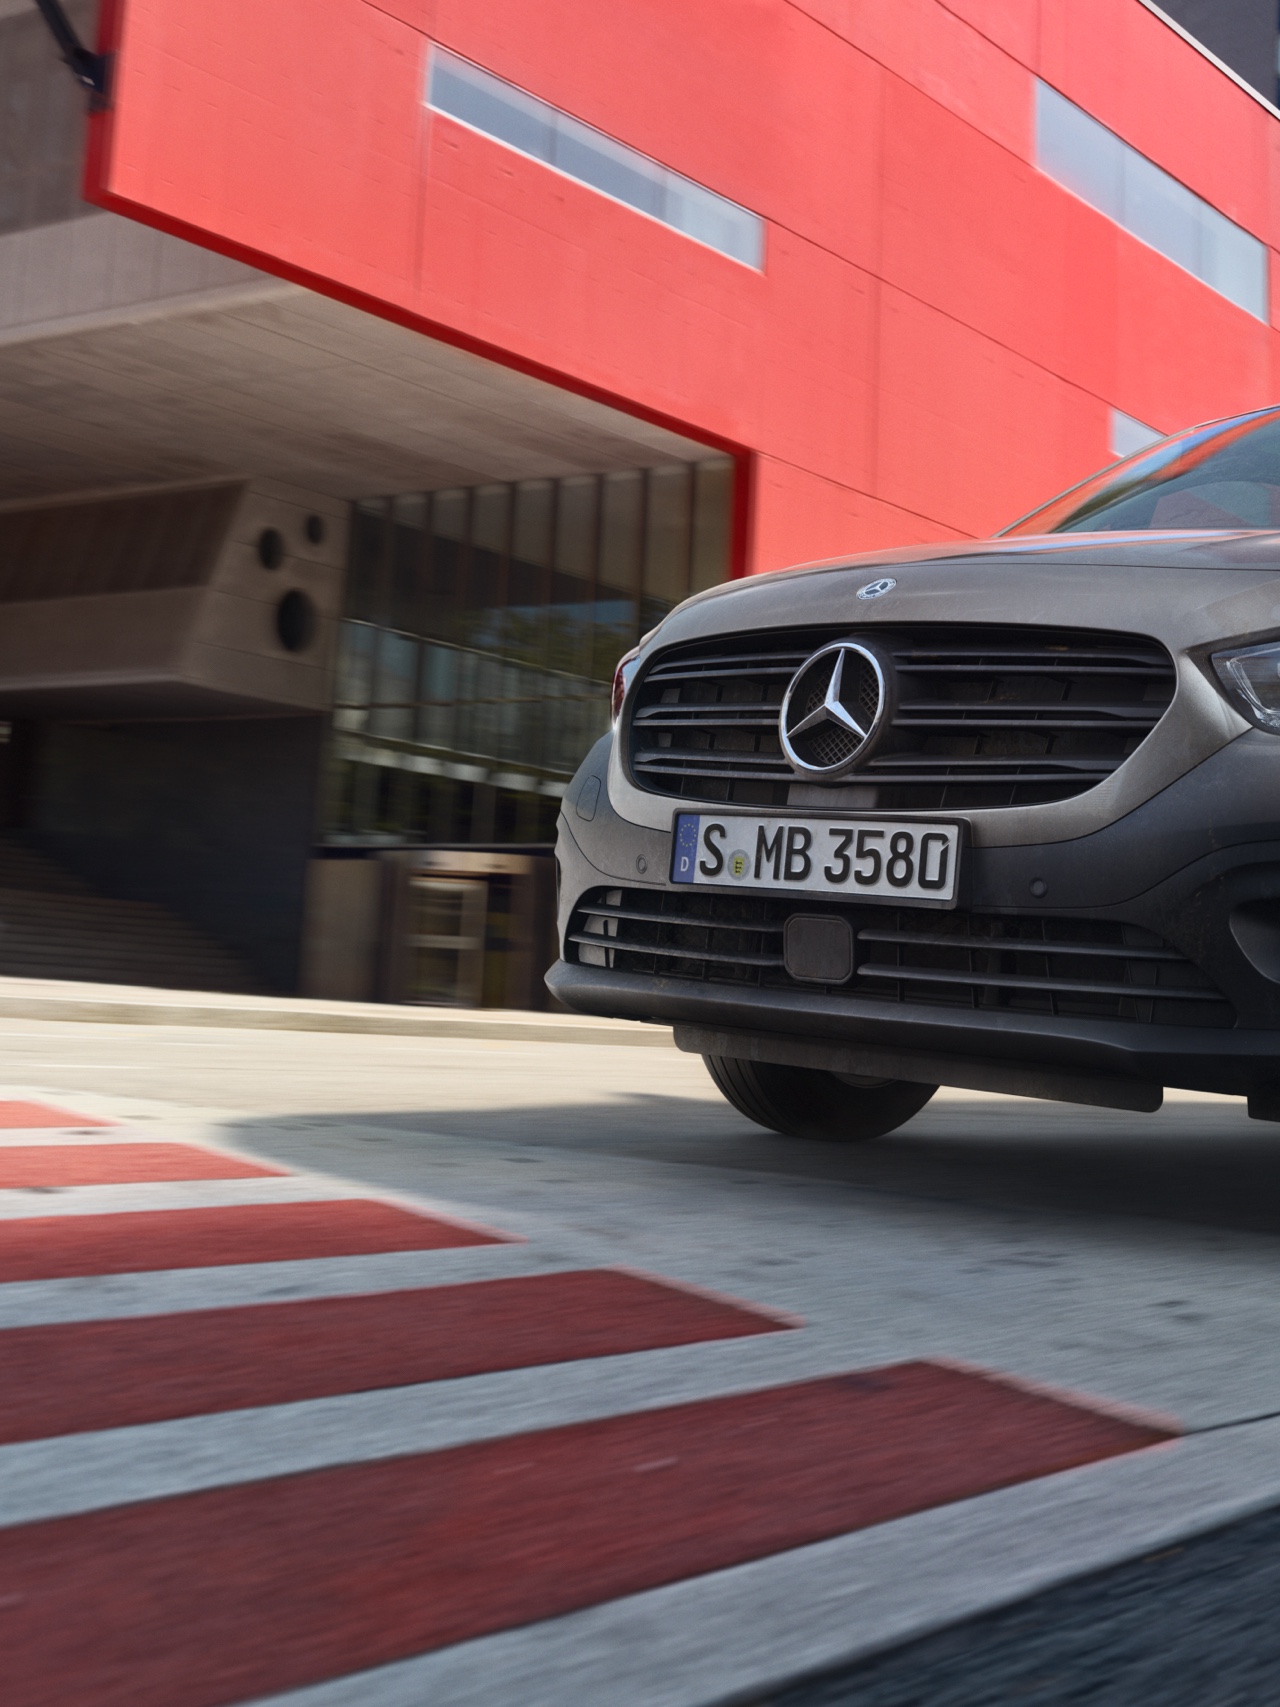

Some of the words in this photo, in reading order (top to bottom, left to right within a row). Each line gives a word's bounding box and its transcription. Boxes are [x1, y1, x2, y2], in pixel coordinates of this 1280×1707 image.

[680, 856, 690, 872] D
[699, 823, 727, 877] S
[753, 825, 812, 881] MB
[823, 828, 951, 890] 3580
